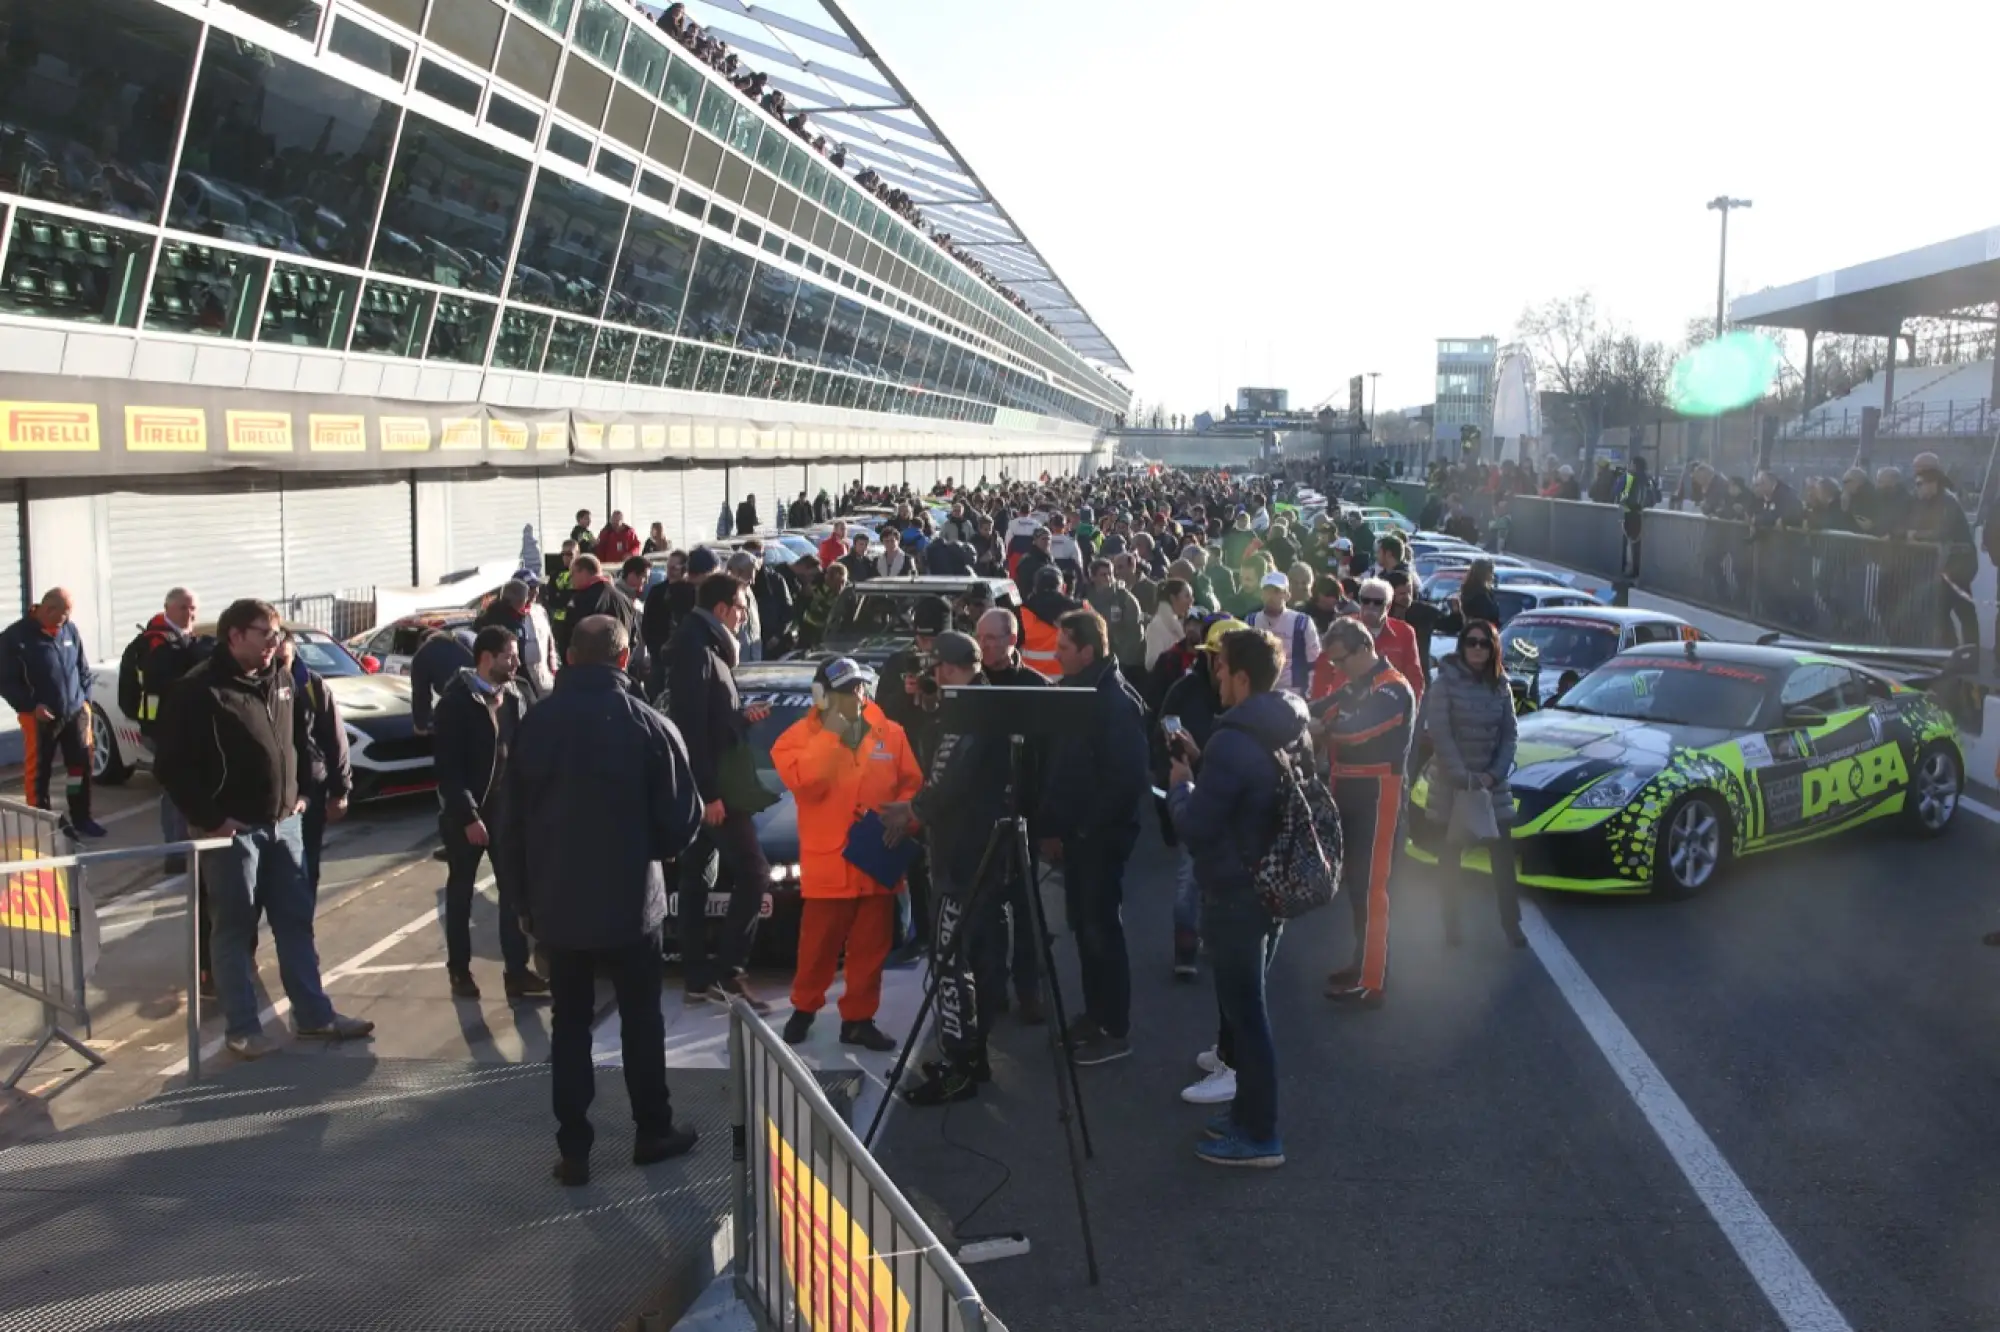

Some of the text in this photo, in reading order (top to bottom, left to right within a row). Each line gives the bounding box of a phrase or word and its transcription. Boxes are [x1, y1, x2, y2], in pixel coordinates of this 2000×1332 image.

[9, 410, 89, 442] PIRELLI
[134, 414, 199, 443] PIRELLI
[233, 418, 286, 444] PIRELLI
[315, 421, 361, 445] PIRELLI
